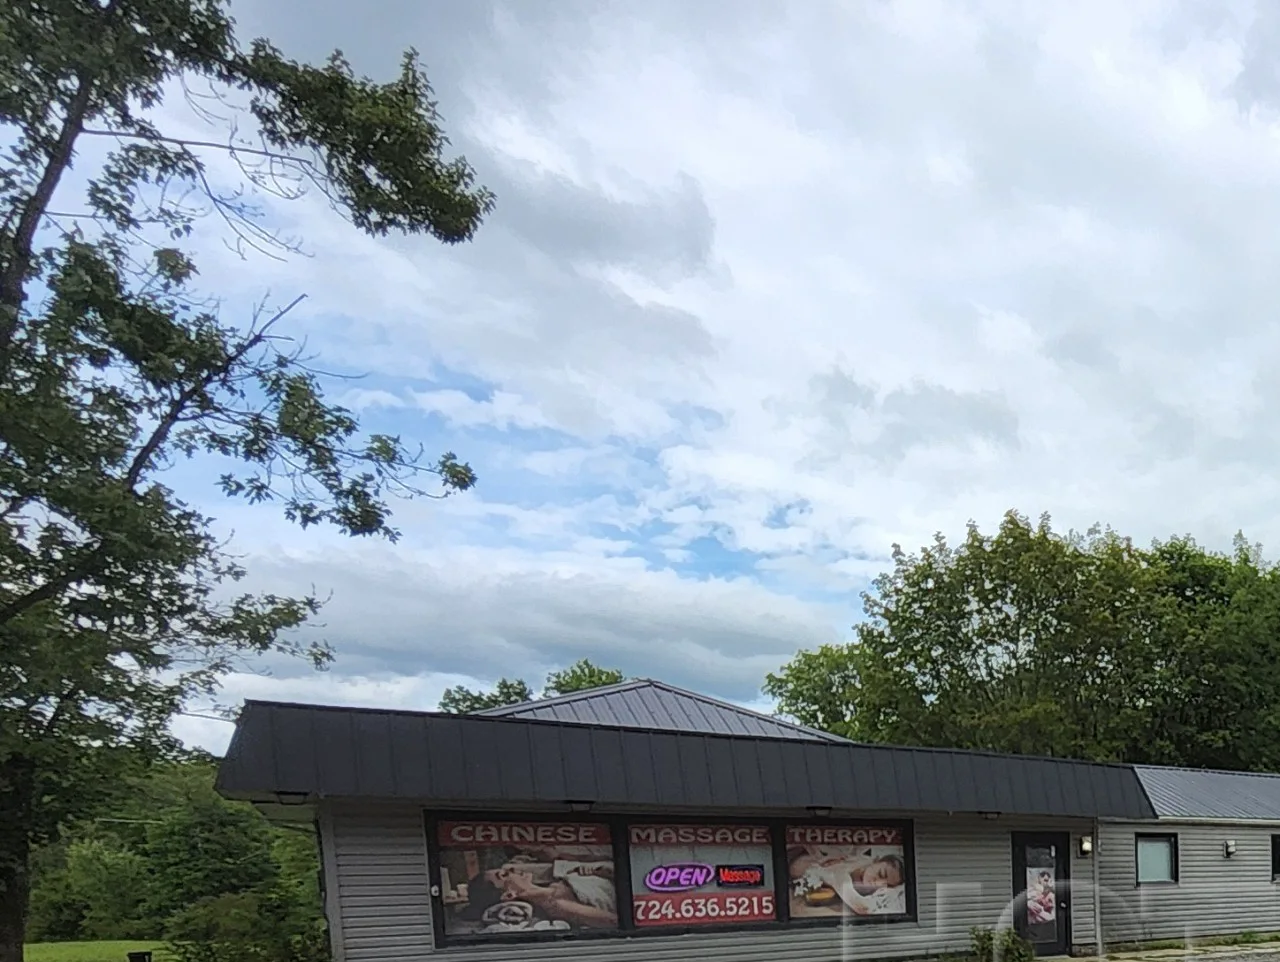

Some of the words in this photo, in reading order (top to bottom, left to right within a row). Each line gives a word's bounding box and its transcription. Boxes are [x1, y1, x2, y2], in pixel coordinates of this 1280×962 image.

[451, 824, 597, 843] CHINESE
[631, 827, 768, 843] MASSAGE
[788, 828, 896, 843] THERAPY
[650, 868, 708, 885] OPEN
[633, 896, 774, 920] 724.636.5215
